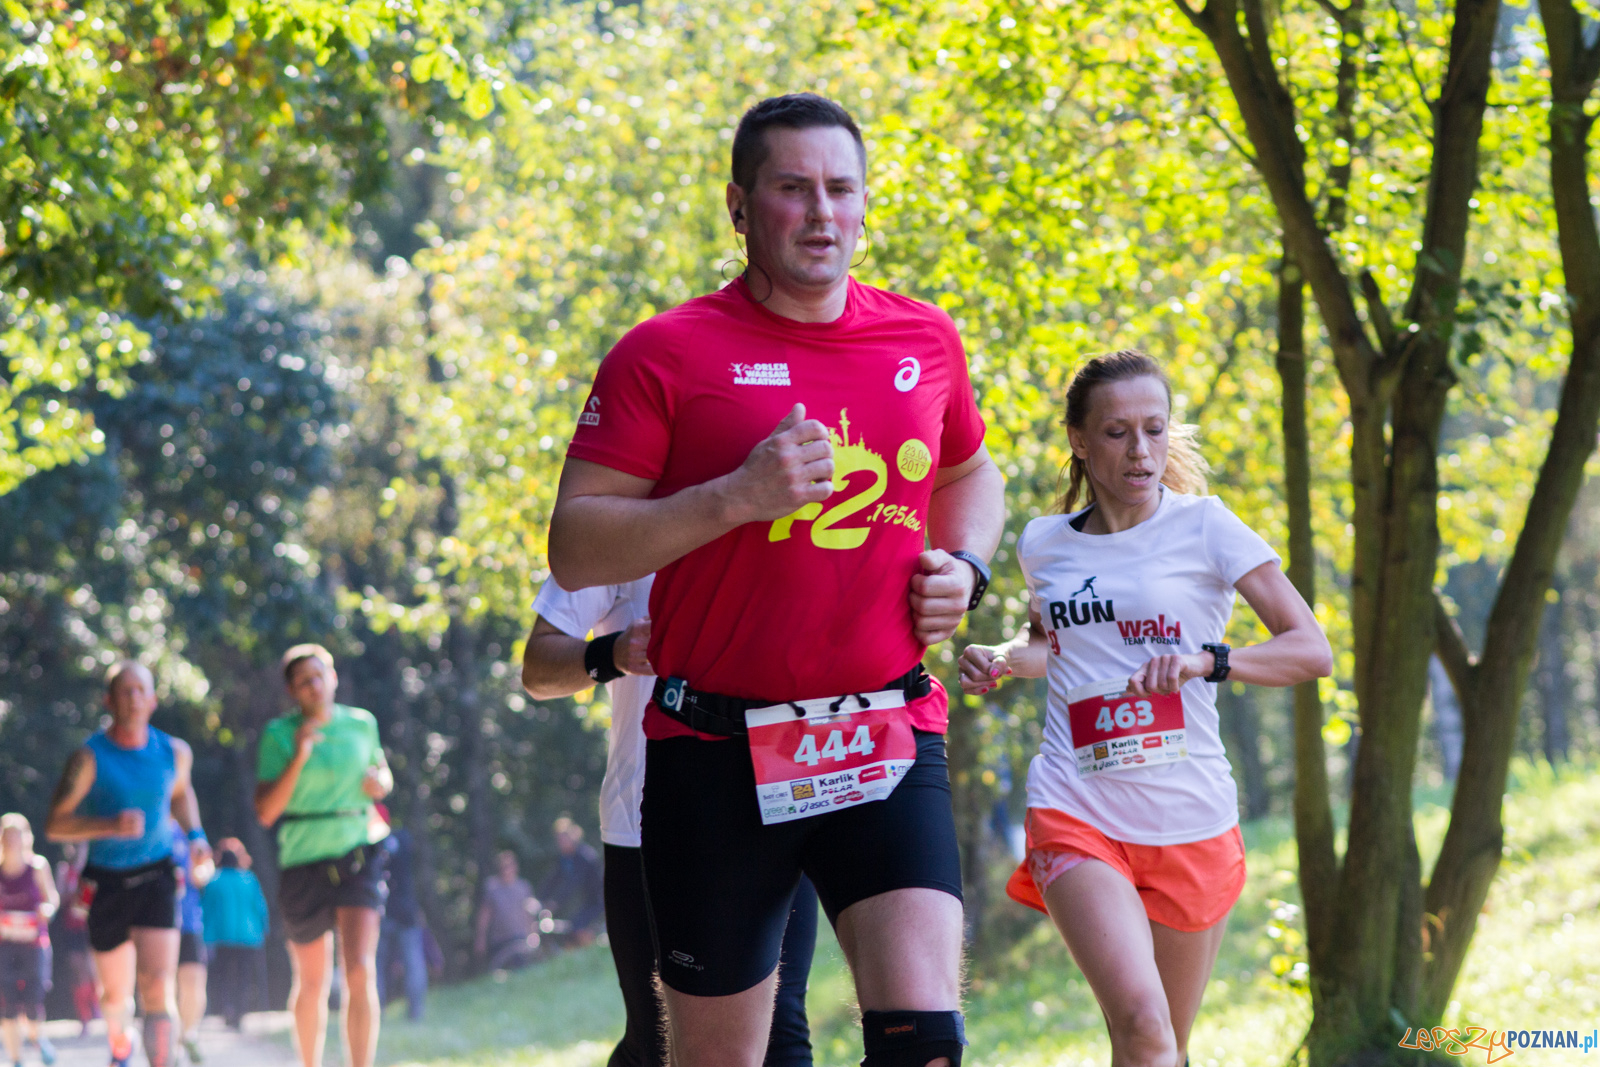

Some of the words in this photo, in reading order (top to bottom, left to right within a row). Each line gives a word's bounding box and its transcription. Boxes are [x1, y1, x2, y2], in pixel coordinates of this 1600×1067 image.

[753, 362, 789, 371] ORLEN
[744, 370, 790, 378] WARSAW
[733, 376, 792, 386] MARATHON
[903, 444, 929, 462] 23.04
[900, 457, 927, 476] 2017
[1122, 637, 1146, 646] TEAM
[1094, 700, 1155, 732] 463
[793, 725, 876, 767] 444
[1111, 739, 1139, 749] Karlik
[819, 773, 855, 787] Karlik
[793, 784, 813, 795] 24
[821, 784, 853, 796] POLAR
